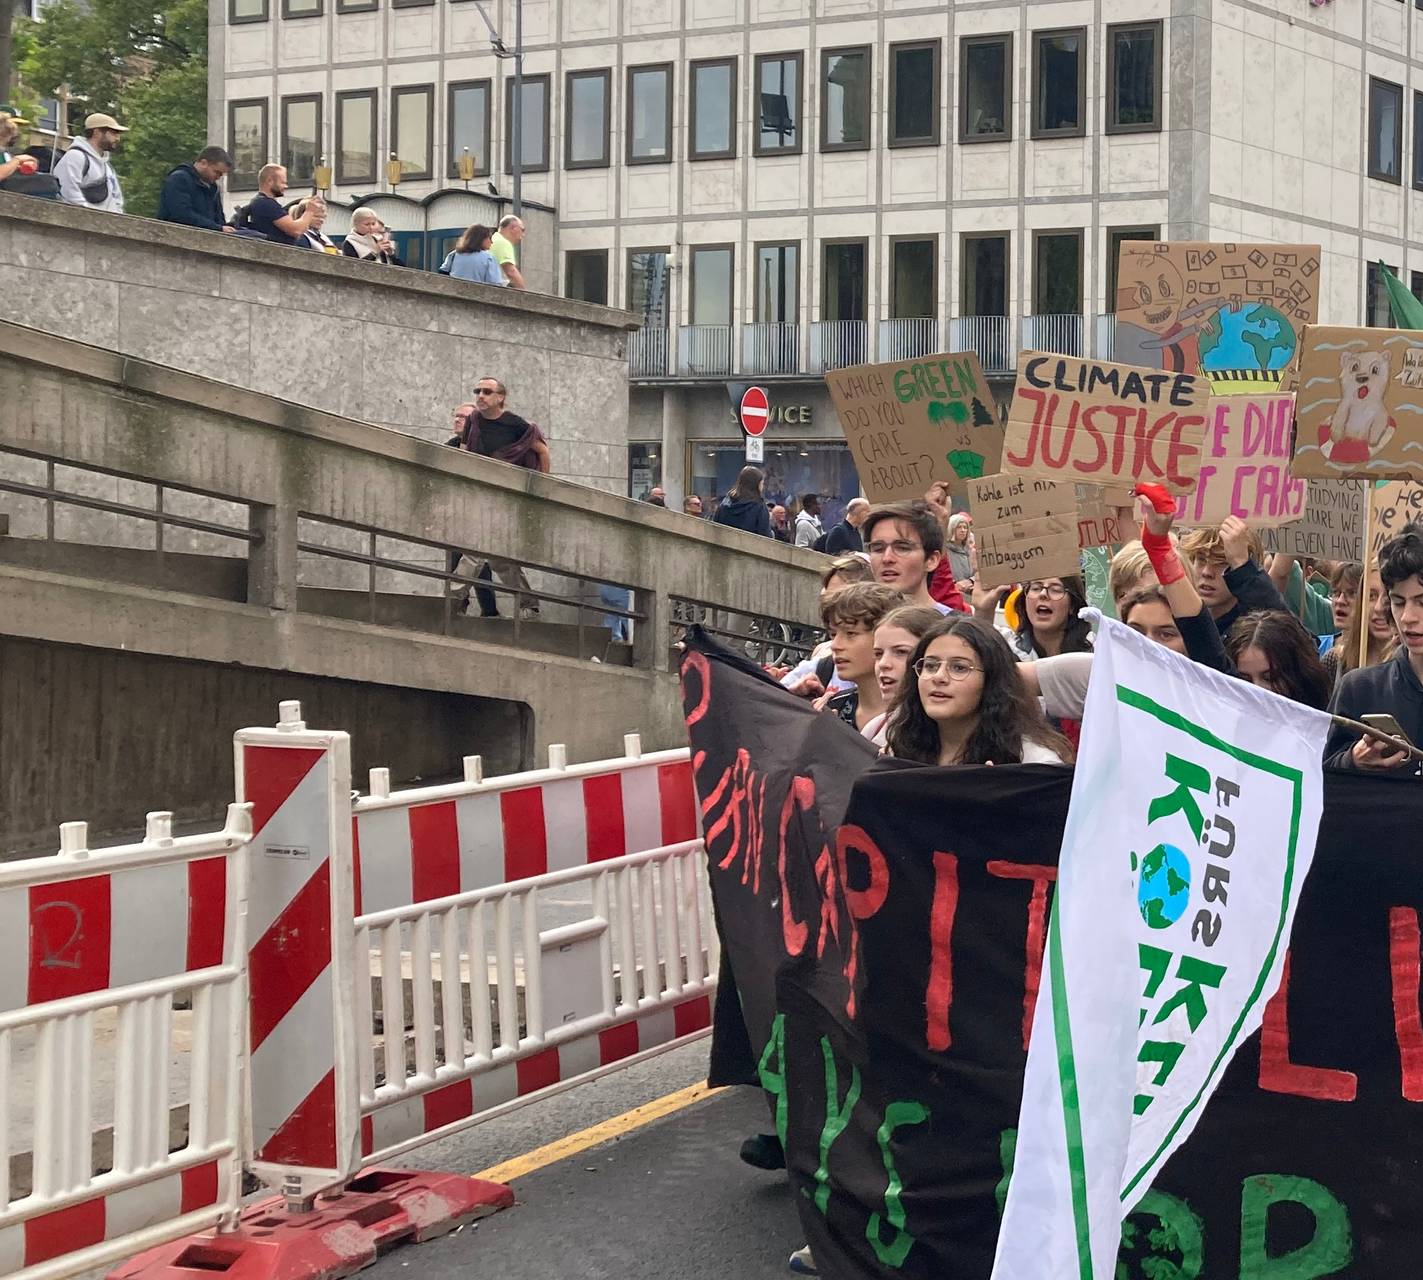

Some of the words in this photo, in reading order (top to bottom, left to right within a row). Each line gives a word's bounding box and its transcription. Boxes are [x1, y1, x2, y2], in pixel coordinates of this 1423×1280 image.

[836, 373, 887, 400] WHICH
[894, 358, 978, 404] GREEN
[1025, 357, 1195, 406] CLIMATE
[844, 406, 870, 431] DO
[872, 400, 905, 426] YOU
[859, 430, 909, 464] CARE
[1007, 387, 1205, 488] JUSTICE
[870, 454, 935, 490] ABOUT?
[976, 484, 1003, 504] Kohle
[1009, 477, 1025, 496] ist
[1231, 465, 1304, 519] CARS
[1307, 487, 1361, 512] TUDYING
[997, 503, 1023, 520] zum
[1306, 508, 1335, 529] TURE
[1341, 514, 1359, 534] WE
[980, 534, 1045, 570] Anbaggern
[1295, 531, 1326, 555] EVEN
[1332, 536, 1363, 562] HAVE
